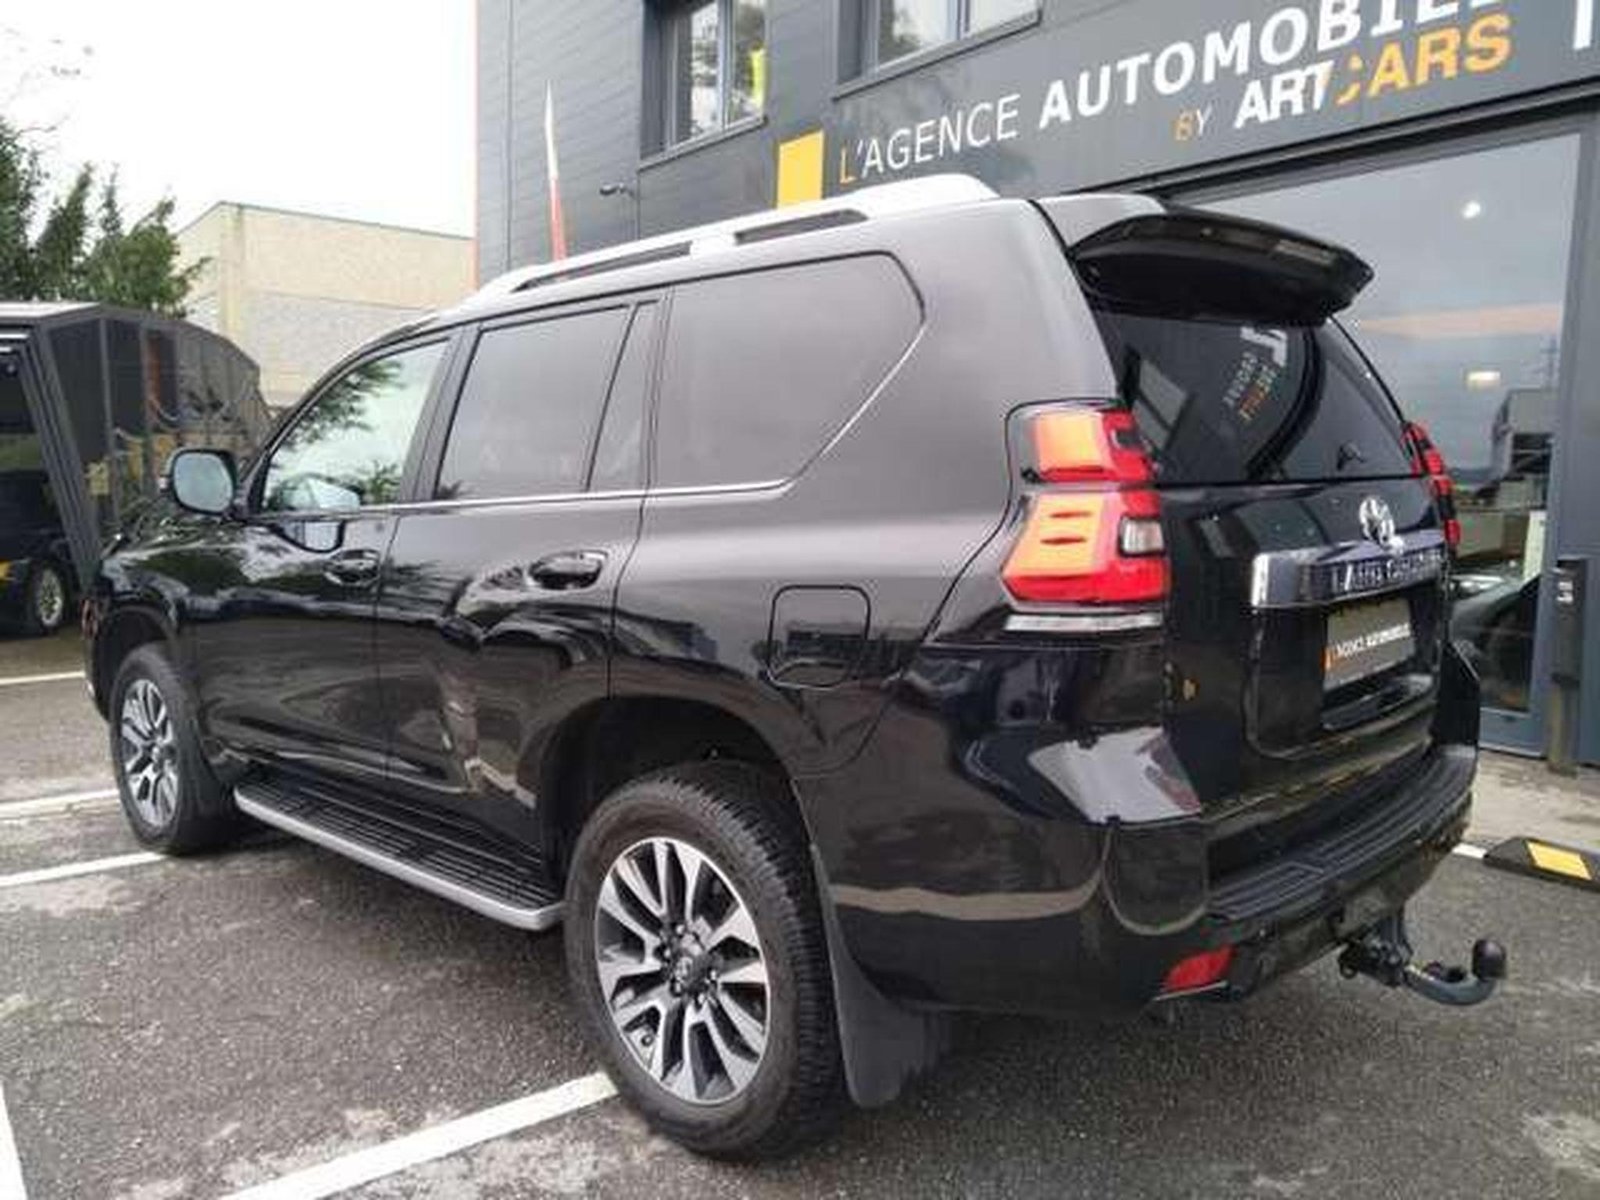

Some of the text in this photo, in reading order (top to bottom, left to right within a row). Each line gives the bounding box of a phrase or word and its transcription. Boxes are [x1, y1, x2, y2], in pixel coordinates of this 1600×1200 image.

[839, 94, 1021, 184] L'AGENCE
[1038, 0, 1502, 129] AUTOMOBI
[1174, 105, 1212, 141] BY
